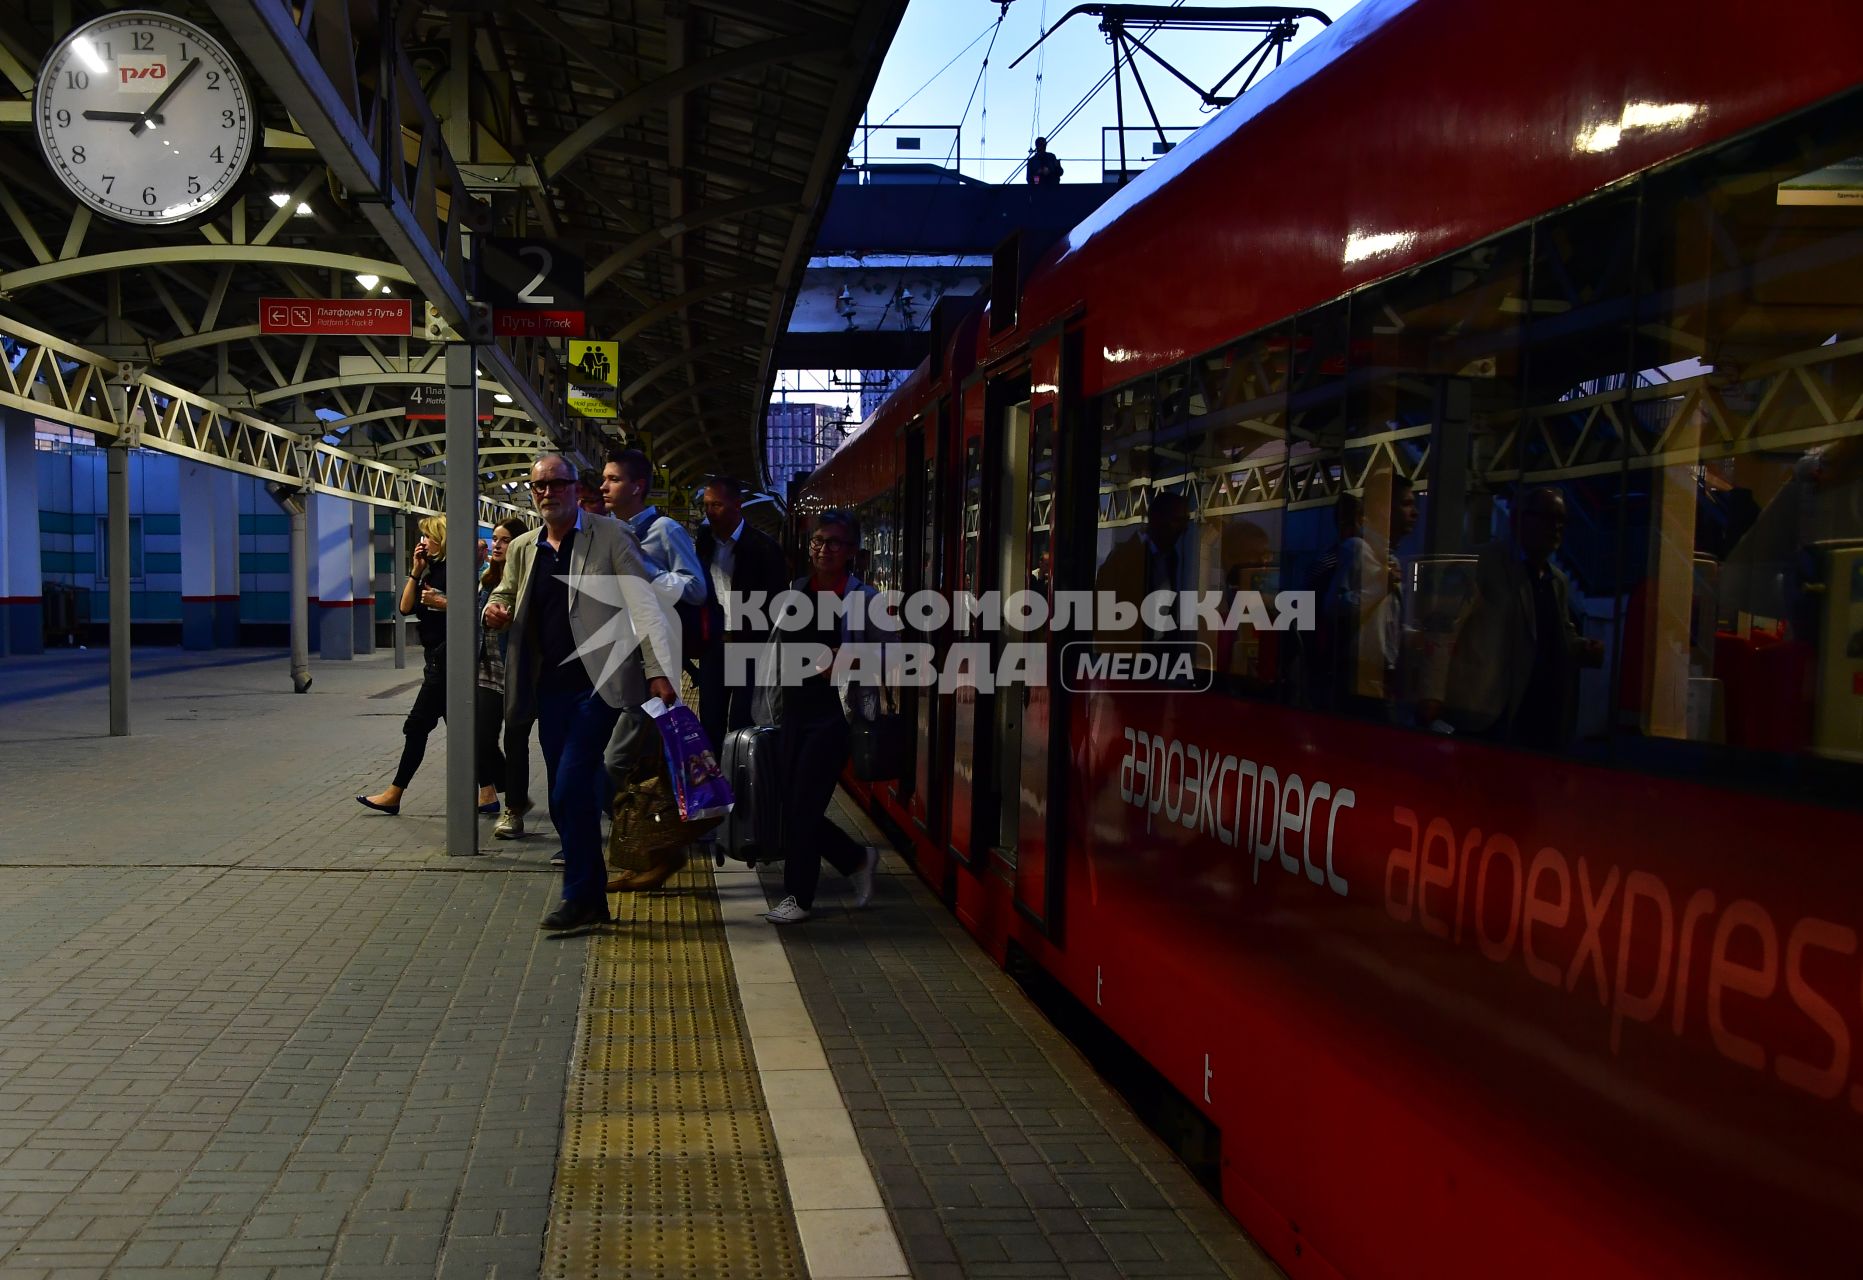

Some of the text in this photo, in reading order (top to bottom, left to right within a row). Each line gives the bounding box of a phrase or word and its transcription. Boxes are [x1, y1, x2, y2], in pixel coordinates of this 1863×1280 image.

[131, 32, 154, 51] 12
[178, 43, 189, 61] 1
[66, 71, 89, 90] 10
[207, 71, 220, 91] 2
[56, 110, 71, 128] 9
[221, 110, 235, 128] 3
[72, 145, 86, 164] 8
[209, 145, 224, 163] 4
[101, 176, 115, 194] 7
[187, 176, 201, 194] 5
[142, 186, 157, 205] 6
[518, 245, 554, 304] 2
[317, 307, 365, 318] Платформа
[366, 308, 373, 317] 5
[374, 308, 395, 318] Путь
[317, 319, 344, 327] Platform
[351, 319, 367, 327] Track
[502, 315, 535, 331] Путь
[543, 318, 572, 329] Track
[410, 386, 423, 404] 4
[425, 386, 446, 395] Плат
[425, 397, 446, 405] Platfo
[1119, 726, 1356, 898] аэроэкспресс
[1384, 804, 1863, 1112] aeroexpres
